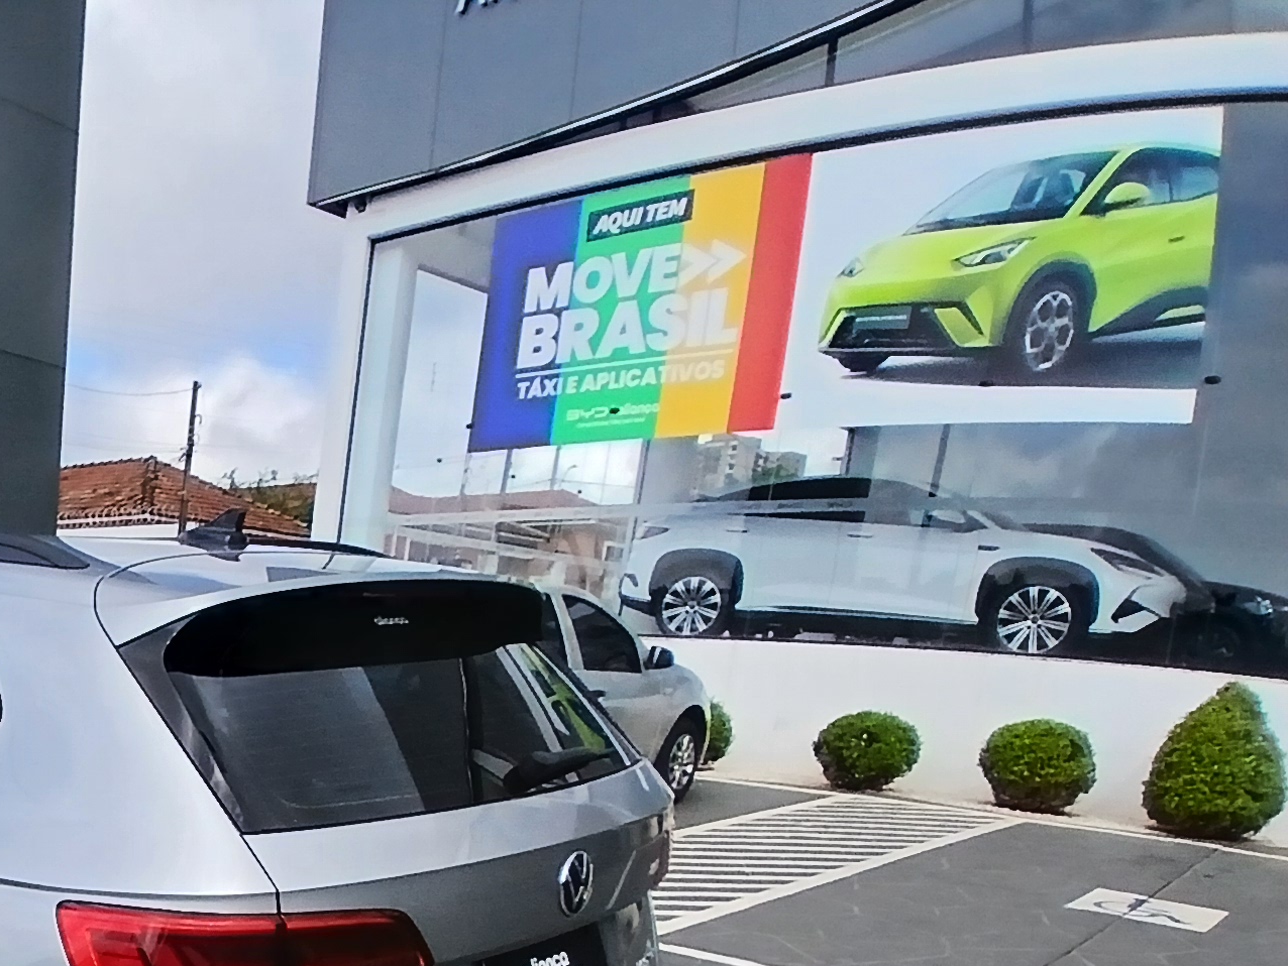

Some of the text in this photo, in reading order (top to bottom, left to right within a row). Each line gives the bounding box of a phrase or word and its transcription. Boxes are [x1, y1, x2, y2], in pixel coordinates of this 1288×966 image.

[593, 197, 687, 234] AQUI TEM
[523, 242, 682, 314] MOVE
[516, 287, 738, 370] BRASIL
[565, 374, 578, 394] E
[580, 359, 725, 393] APLICATIVOS
[566, 406, 609, 421] BYD
